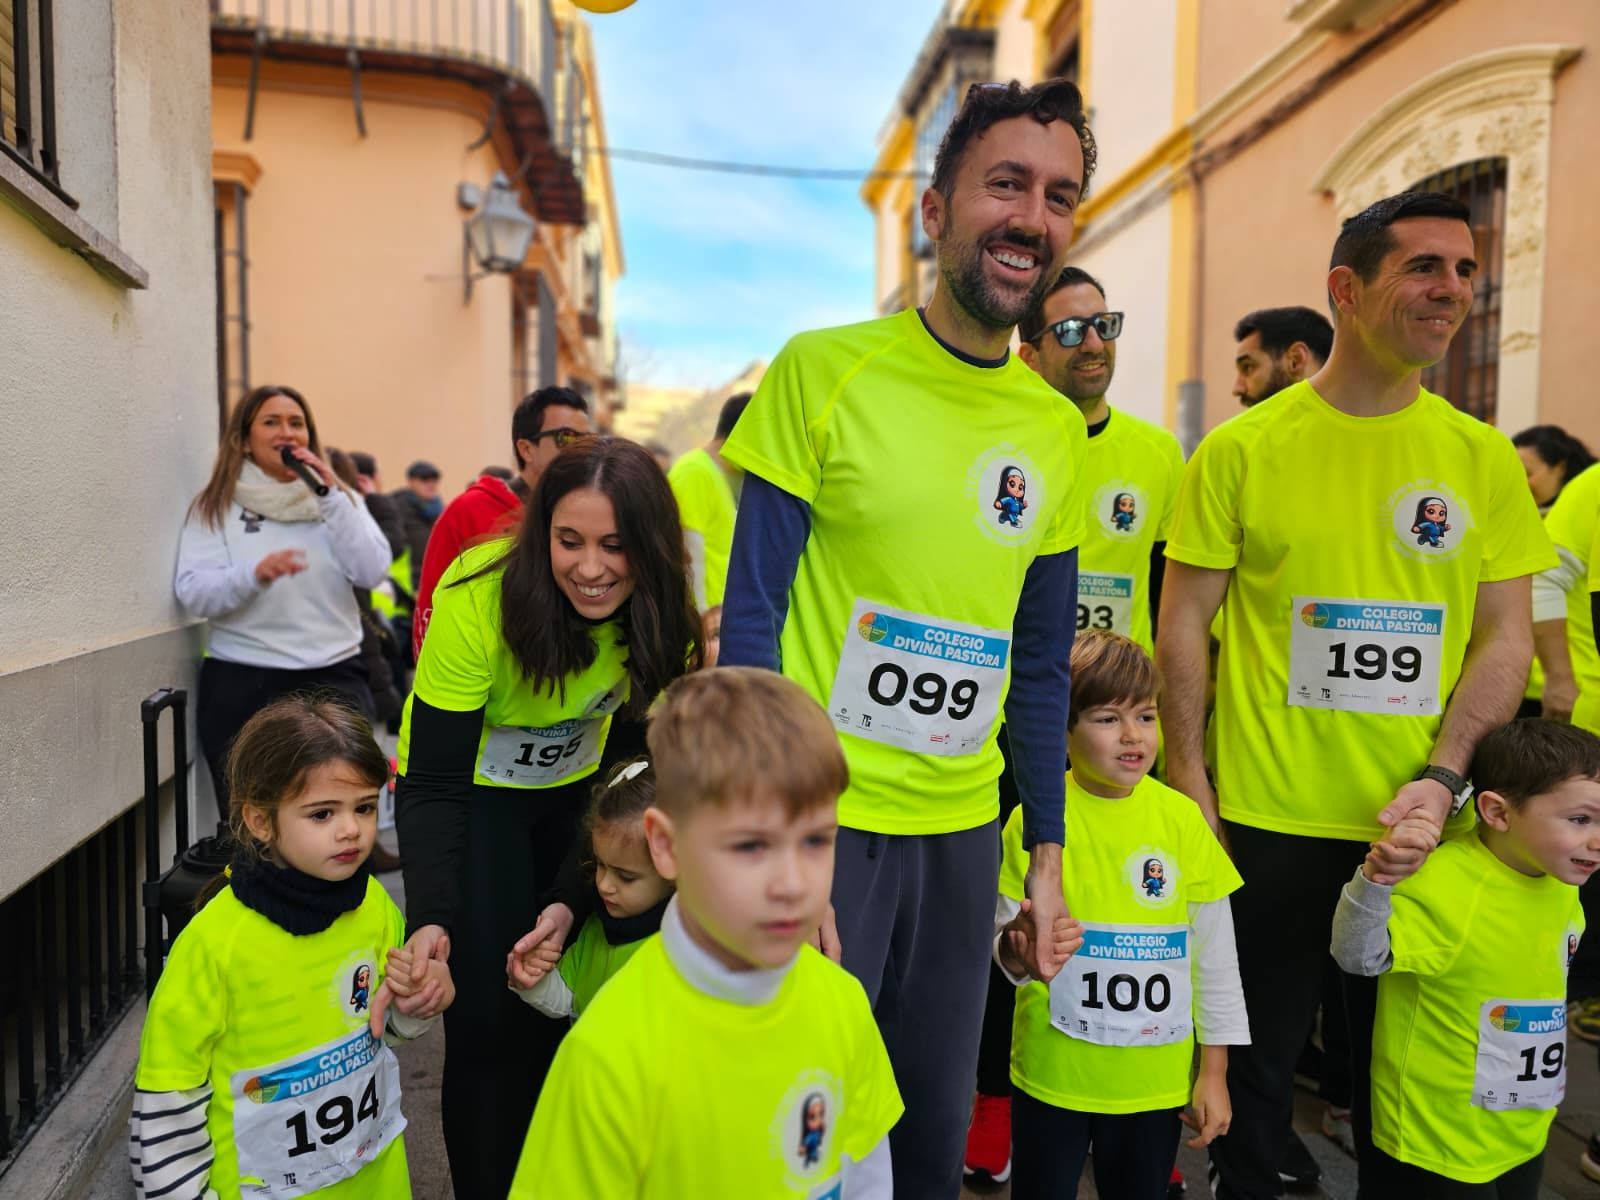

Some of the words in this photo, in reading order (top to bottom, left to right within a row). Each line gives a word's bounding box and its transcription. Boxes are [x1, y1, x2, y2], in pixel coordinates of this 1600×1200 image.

[1336, 618, 1384, 630] DIVINA
[1387, 620, 1438, 634] PASTORA
[1362, 608, 1423, 621] COLEGIO
[893, 635, 942, 657] DIVINA
[945, 646, 1000, 667] PASTORA
[924, 628, 985, 650] COLEGIO
[1326, 642, 1422, 683] 199
[868, 662, 979, 720] 099
[514, 732, 584, 767] 195
[1089, 945, 1136, 959] DIVINA
[1137, 946, 1183, 960] PASTORA
[1113, 934, 1168, 947] COLEGIO
[1081, 971, 1172, 1013] 100
[290, 1064, 345, 1096] DIVINA
[344, 1042, 379, 1073] PASTO
[1516, 1041, 1567, 1082] 19
[285, 1074, 380, 1158] 194
